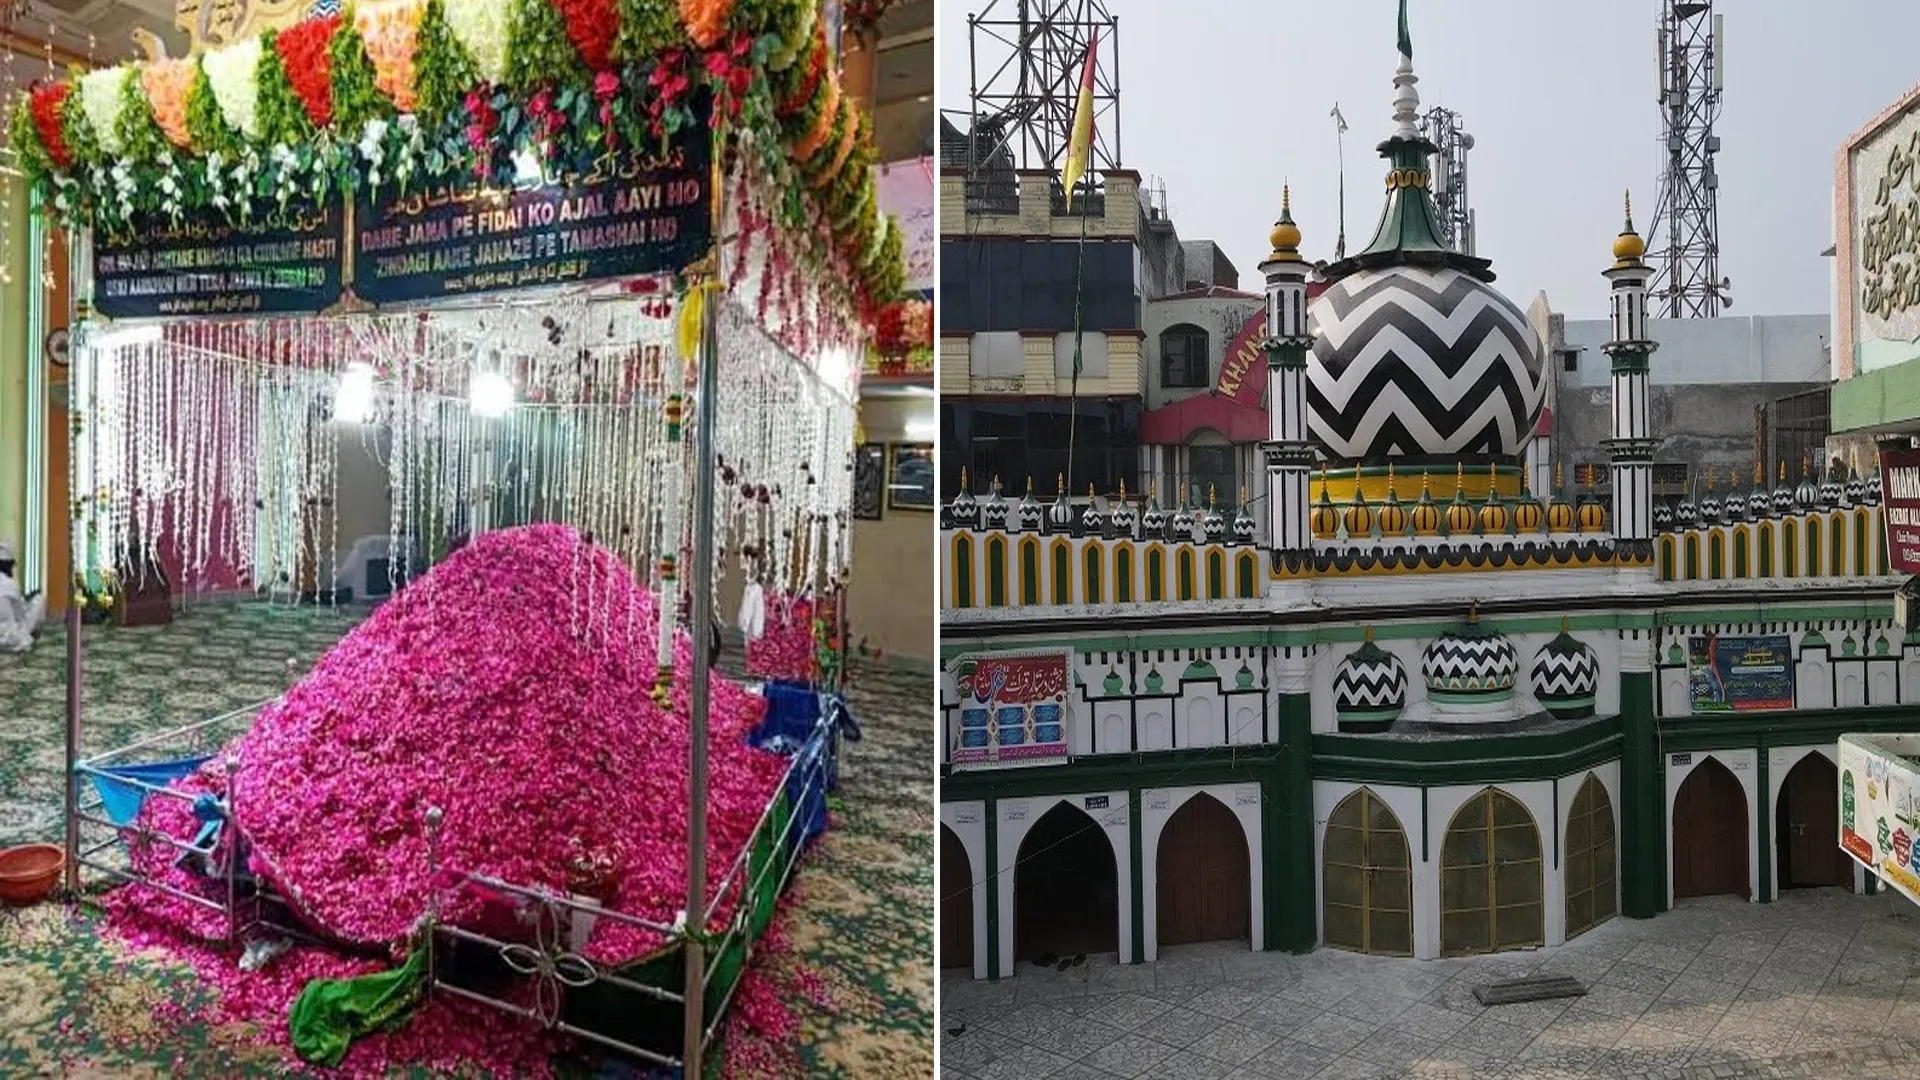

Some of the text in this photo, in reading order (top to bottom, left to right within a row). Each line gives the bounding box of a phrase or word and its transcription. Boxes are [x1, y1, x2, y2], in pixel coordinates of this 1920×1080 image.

[452, 214, 473, 238] PE
[477, 207, 523, 235] FIDAI
[527, 201, 555, 228] KO
[559, 195, 608, 222] AJAL
[613, 185, 661, 216] AAYI
[667, 178, 700, 207] HO
[303, 238, 336, 259] HASTI
[535, 232, 556, 258] PE
[560, 221, 646, 253] TAMASHAI
